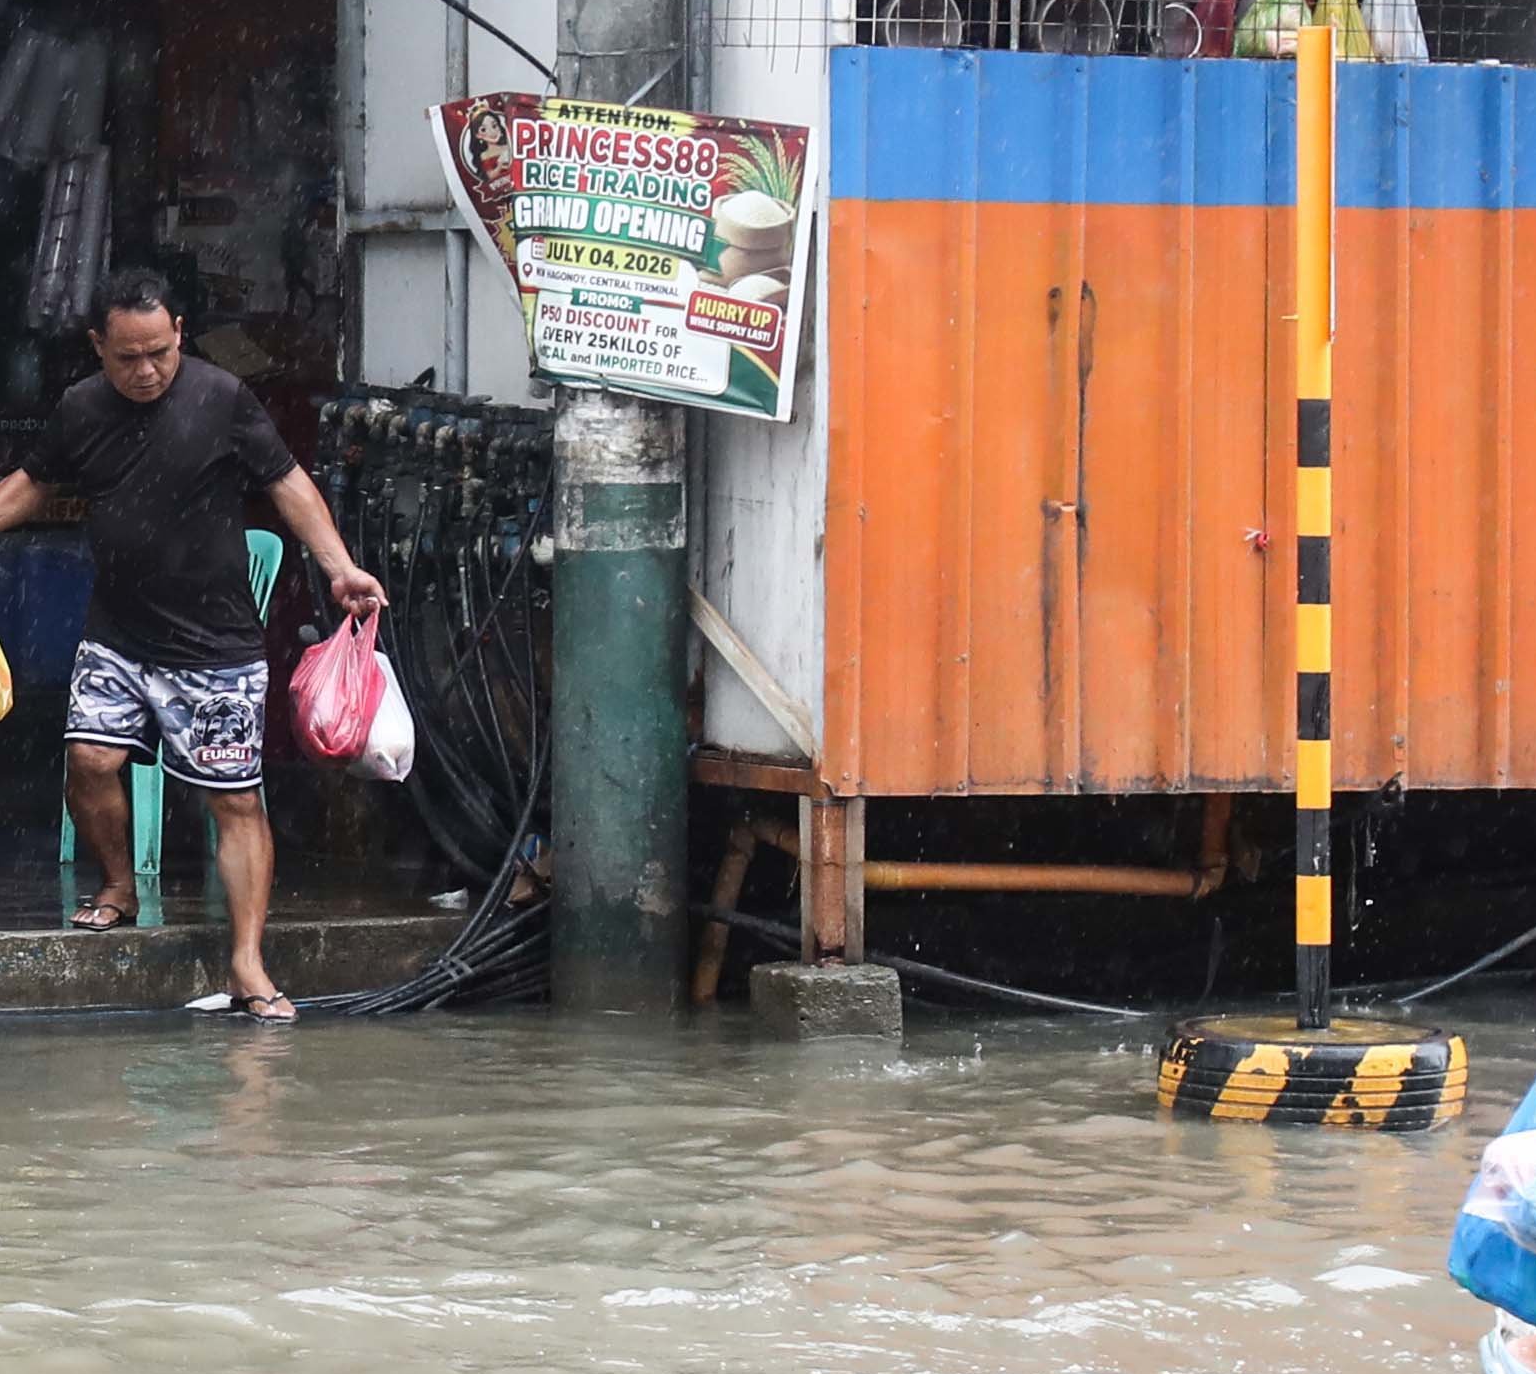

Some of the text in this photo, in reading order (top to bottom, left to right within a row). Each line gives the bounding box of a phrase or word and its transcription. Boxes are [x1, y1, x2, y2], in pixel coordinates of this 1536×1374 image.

[559, 104, 676, 132] ATTENTION:
[514, 121, 716, 178] PRINCESS88
[525, 161, 710, 207] RICE TRADING
[515, 194, 707, 253] GRAND OPENING
[546, 241, 672, 276] JULY 04, 2026
[589, 273, 632, 291] CENTRAL
[634, 282, 679, 297] TERMINAL
[579, 291, 633, 311] PROMO:
[694, 296, 772, 328] HURRY UP
[566, 309, 651, 335] DISCOUNT
[655, 325, 678, 339] FOR
[588, 332, 658, 357] 25KILOS
[663, 344, 683, 359] OF
[570, 353, 591, 364] and
[595, 354, 663, 375] IMPORTED
